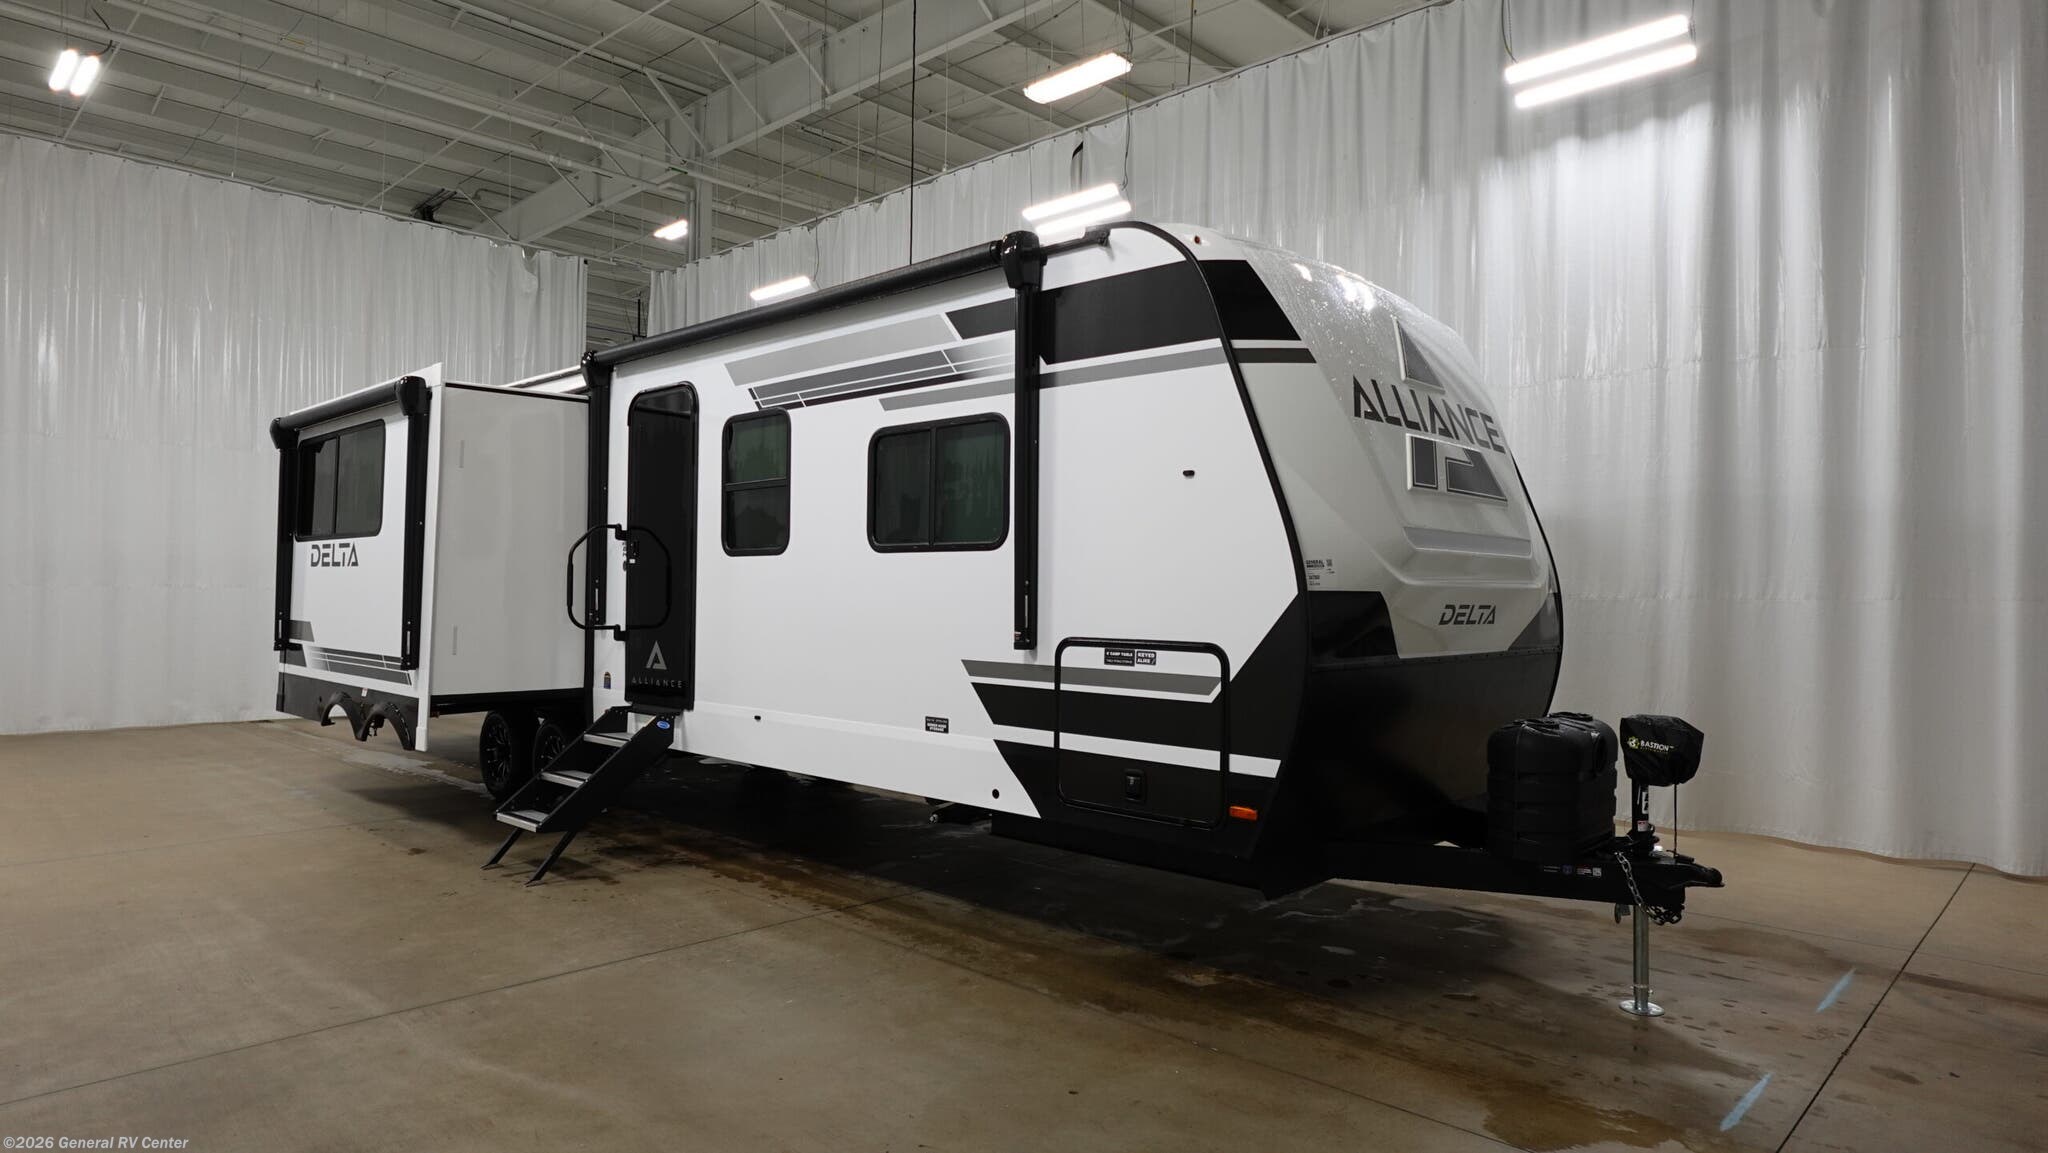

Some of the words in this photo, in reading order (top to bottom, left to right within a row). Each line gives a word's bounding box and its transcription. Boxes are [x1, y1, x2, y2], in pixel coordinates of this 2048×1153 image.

[1353, 375, 1506, 454] ALLIANCE
[310, 542, 359, 568] DELTA
[1438, 604, 1496, 625] DELTA
[631, 676, 683, 689] ALLIANCE
[1640, 740, 1669, 751] BASTION
